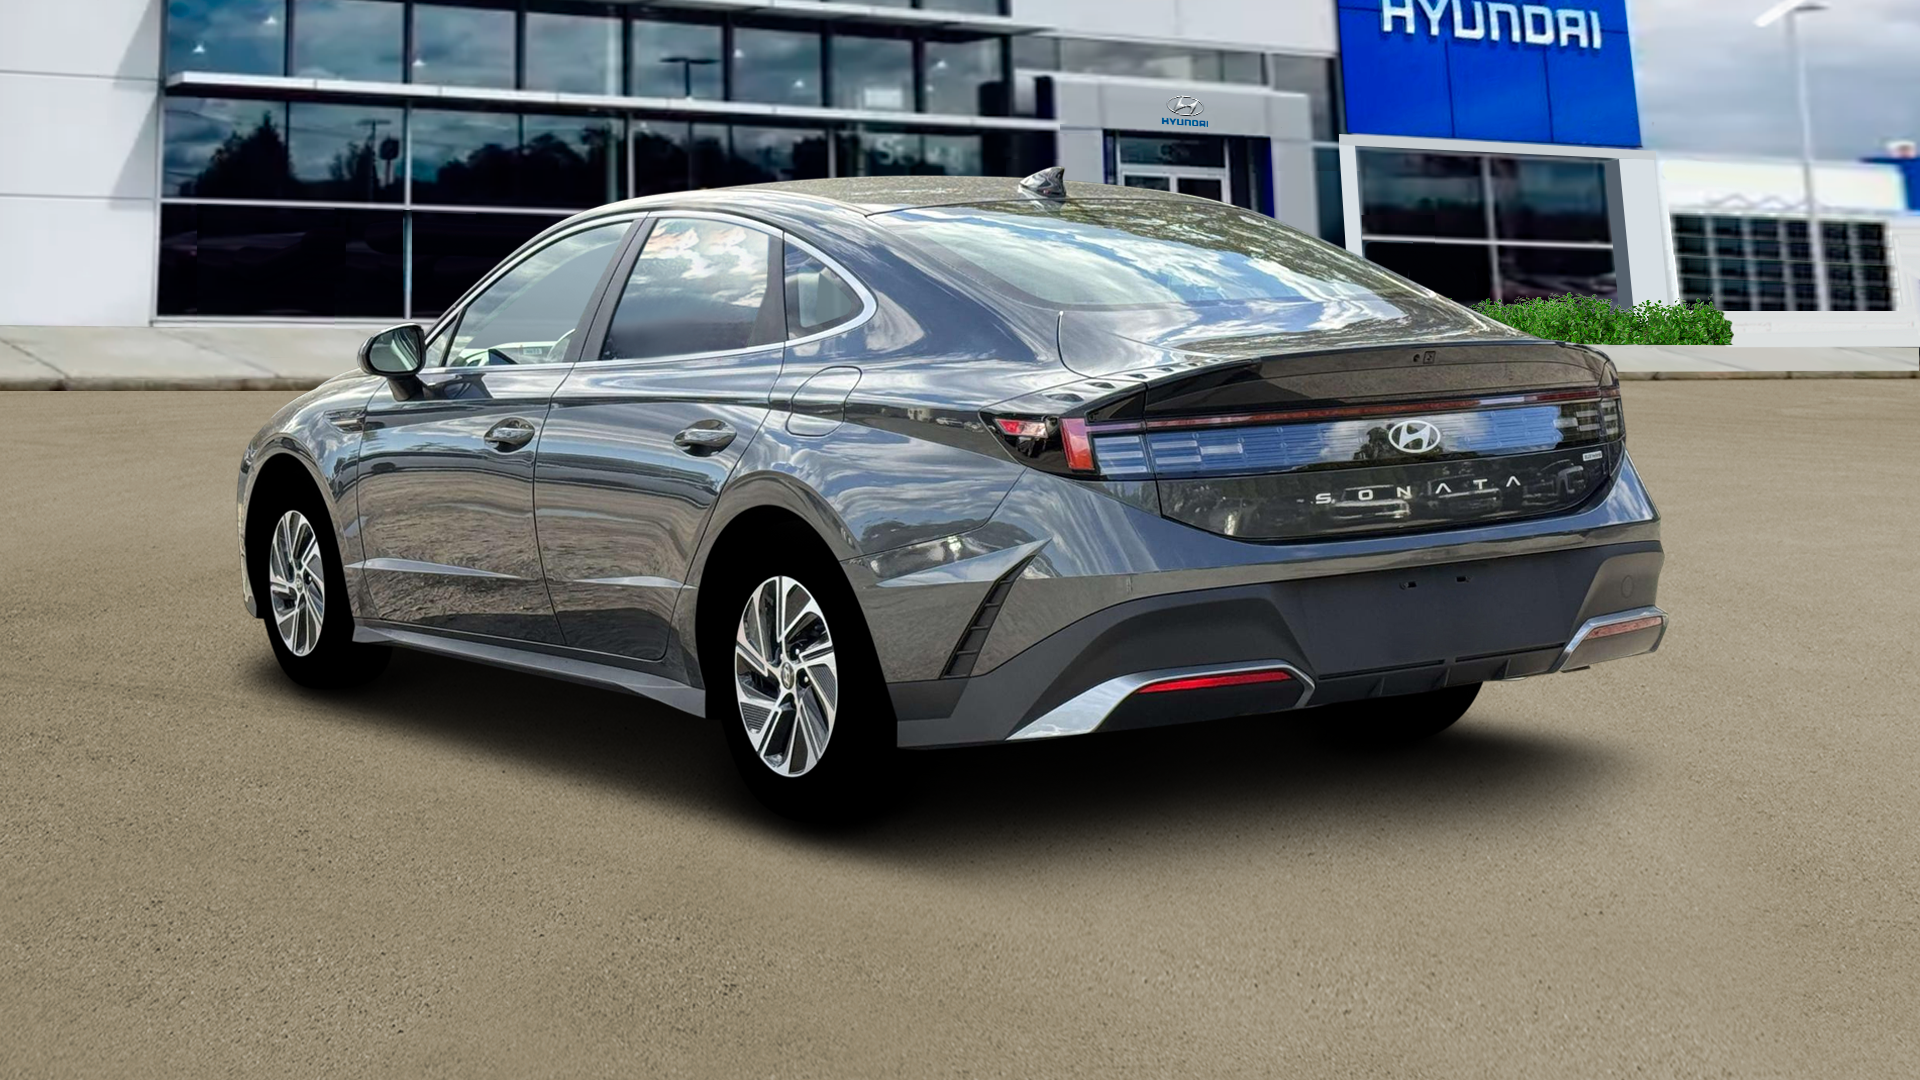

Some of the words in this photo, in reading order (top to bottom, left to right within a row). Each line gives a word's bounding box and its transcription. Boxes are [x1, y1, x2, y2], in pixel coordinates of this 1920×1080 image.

[1382, 0, 1601, 49] HYUNDAI
[1161, 117, 1209, 128] HYUNDAI
[1315, 475, 1521, 504] SONATA
